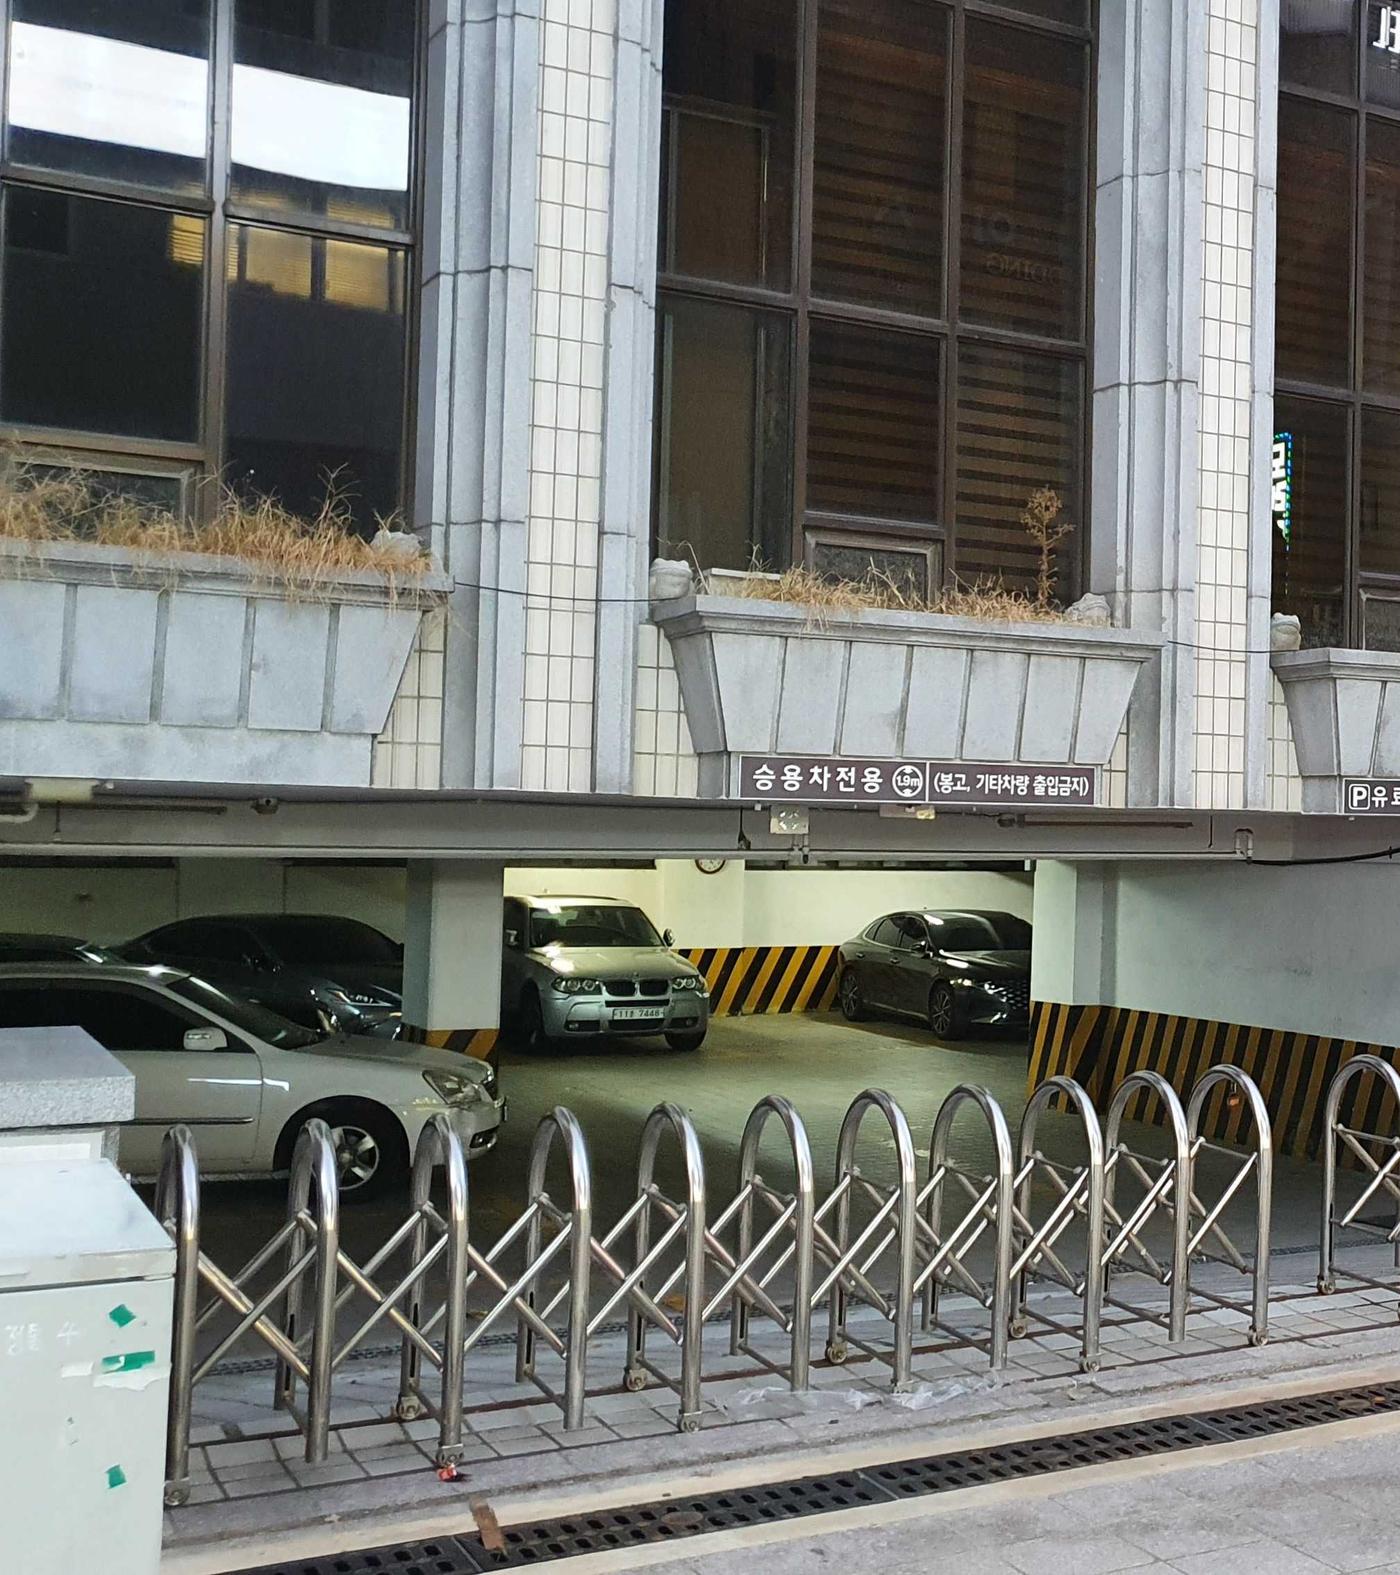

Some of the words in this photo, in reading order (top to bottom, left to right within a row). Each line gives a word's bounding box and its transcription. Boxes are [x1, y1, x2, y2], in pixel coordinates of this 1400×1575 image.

[753, 764, 883, 792] 승용차전용
[934, 772, 971, 794] (봉고,
[976, 773, 1028, 796] 기타차량
[1033, 774, 1089, 797] 출입금지)
